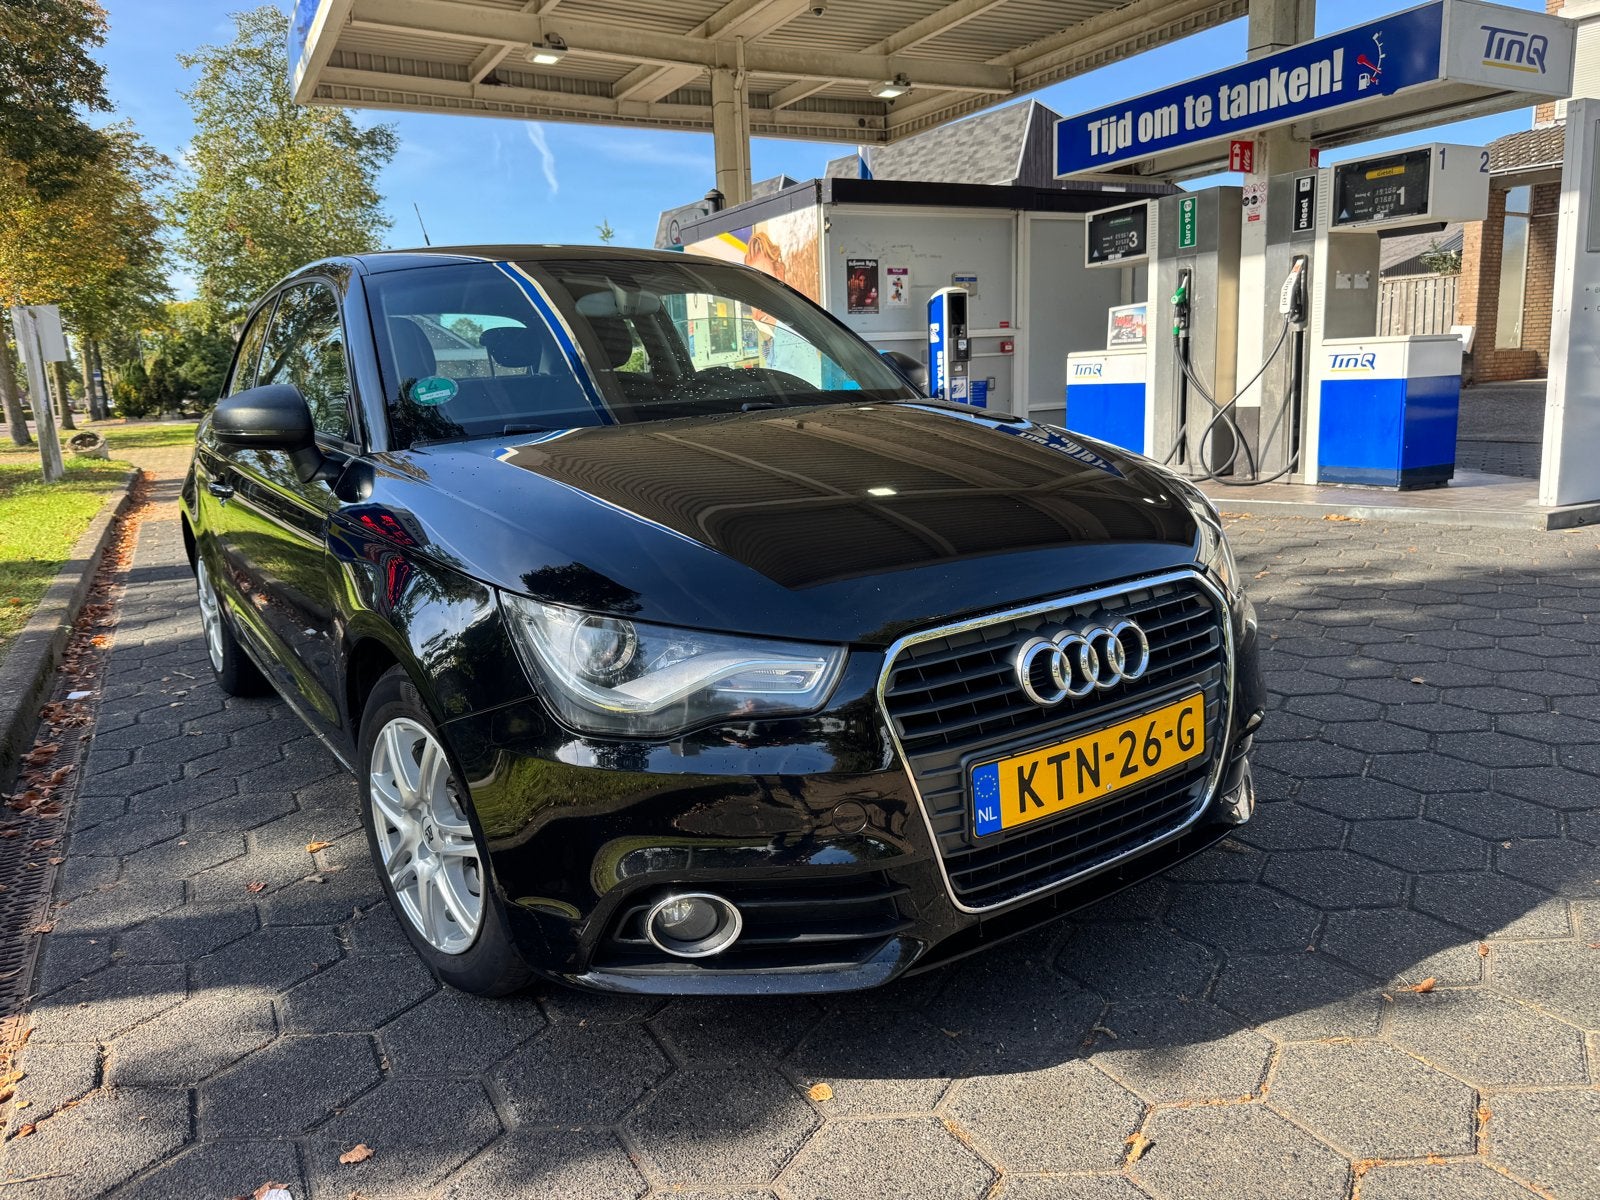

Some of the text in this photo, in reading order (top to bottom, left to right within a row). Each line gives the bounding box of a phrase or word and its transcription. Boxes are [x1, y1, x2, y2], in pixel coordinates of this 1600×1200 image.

[1480, 25, 1548, 74] TinQ
[1088, 48, 1344, 156] Tijd om te tanken!
[1439, 148, 1446, 170] 1
[1479, 151, 1489, 173] 2
[1396, 186, 1405, 206] 1
[1184, 212, 1191, 223] 95
[1299, 198, 1309, 228] Diesel
[1129, 231, 1138, 247] 3
[1073, 363, 1102, 377] TinQ
[1328, 352, 1376, 370] TinQ
[1017, 706, 1195, 814] KTN-26-G
[978, 805, 998, 824] NL
